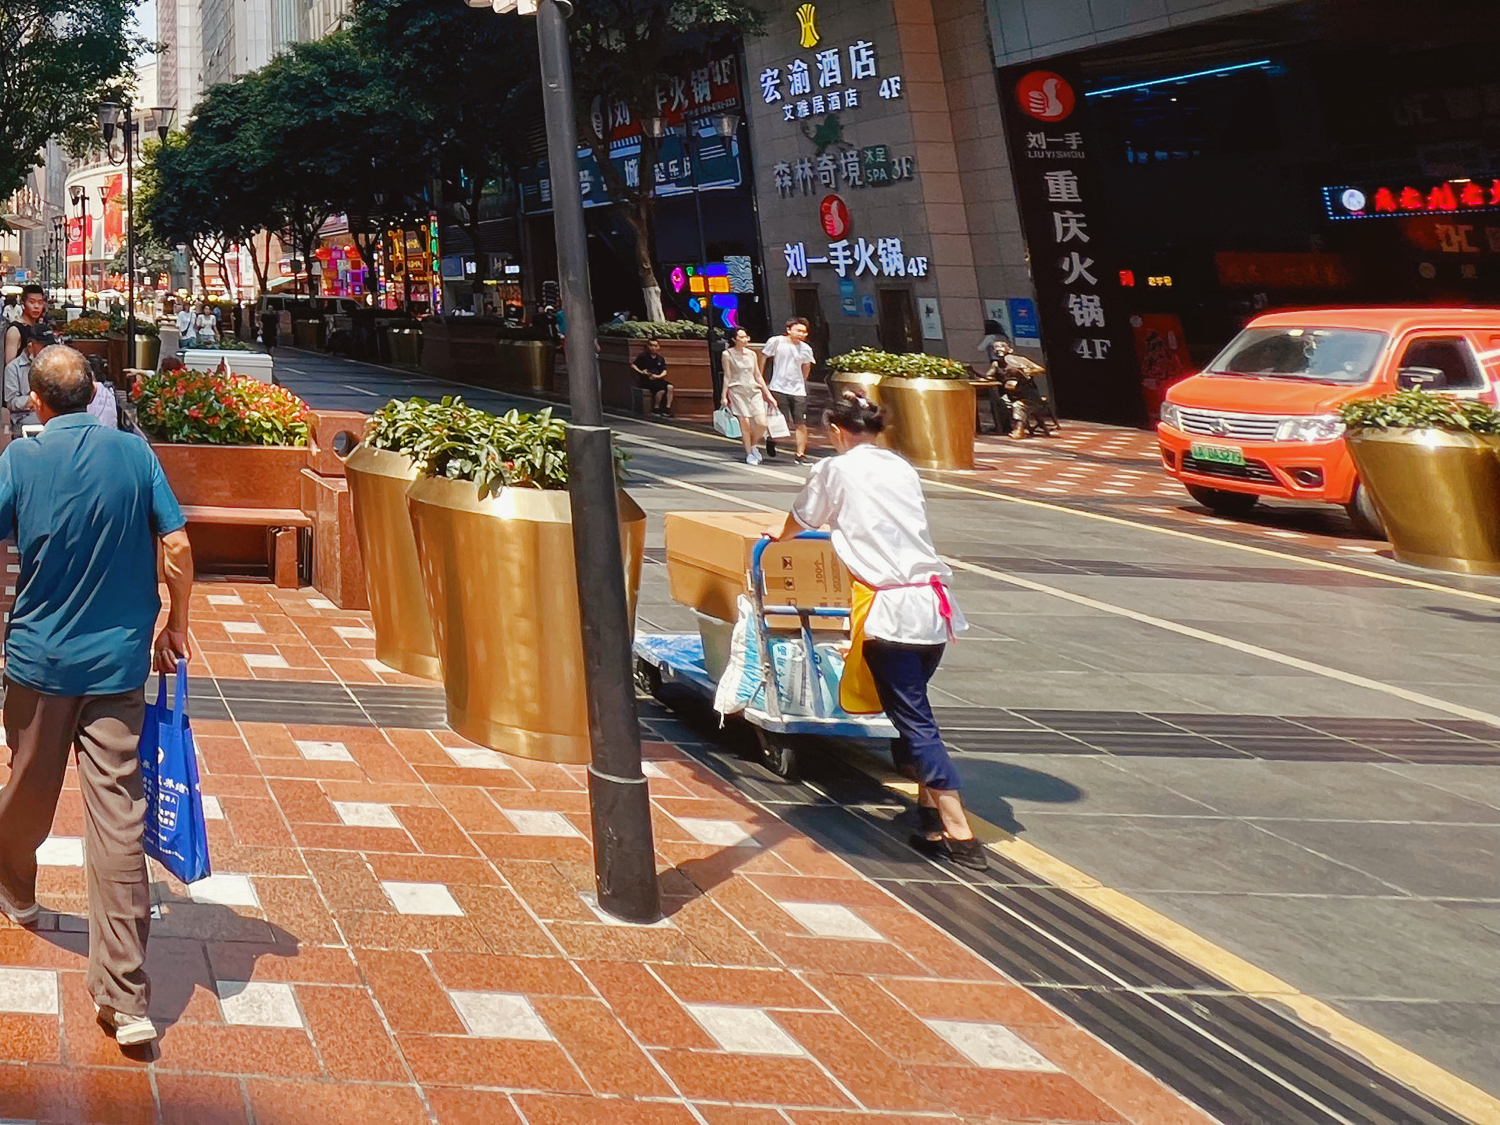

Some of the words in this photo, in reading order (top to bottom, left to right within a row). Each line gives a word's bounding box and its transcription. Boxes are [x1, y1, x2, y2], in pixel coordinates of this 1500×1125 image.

[759, 40, 877, 104] 宏渝酒店
[878, 75, 901, 100] 4F
[1026, 131, 1084, 150] 刘一手
[773, 150, 863, 196] 森林奇境
[866, 169, 888, 183] SPA
[891, 156, 914, 180] 3F
[783, 237, 906, 278] 刘一手火锅
[906, 256, 928, 277] 4F
[1043, 170, 1106, 328] 重庆火锅
[1076, 338, 1112, 360] 4F
